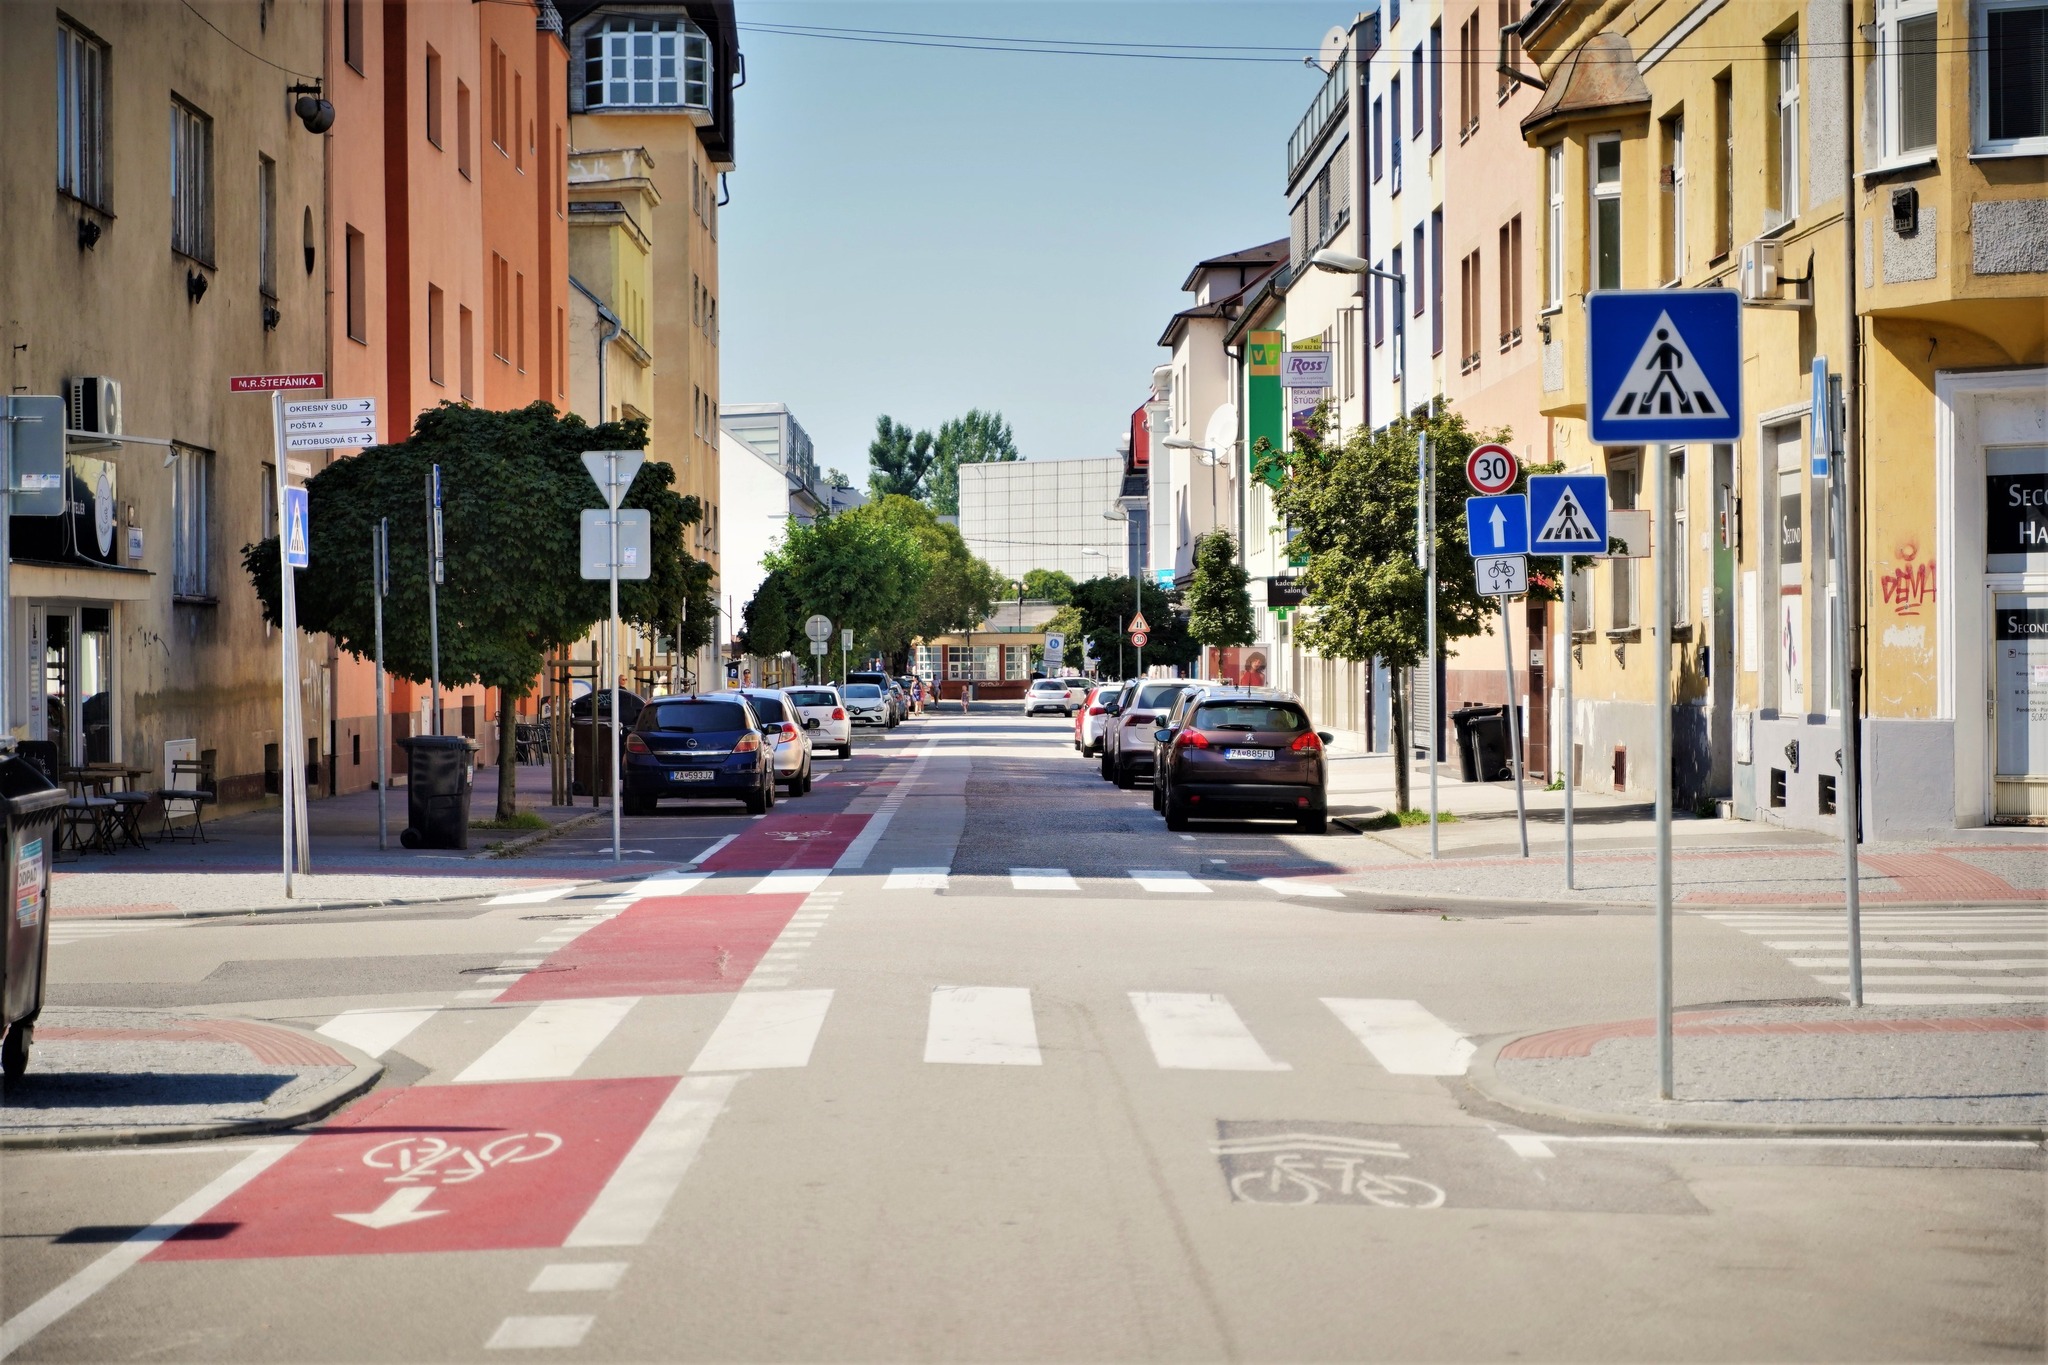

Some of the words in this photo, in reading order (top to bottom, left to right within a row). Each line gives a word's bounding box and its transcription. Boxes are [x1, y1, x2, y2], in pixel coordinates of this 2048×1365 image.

[1291, 358, 1323, 375] Ross
[238, 376, 317, 389] M.R.ŠTEFÁNIKA
[289, 402, 329, 413] OKRESNÝ
[331, 402, 348, 411] SÚD
[290, 420, 317, 430] POŠTA
[291, 436, 345, 446] AUTOBUSOVÁ
[347, 436, 359, 444] ST.
[1478, 457, 1507, 481] 30
[71, 500, 86, 515] TELIÉR
[1283, 586, 1301, 594] salón
[1135, 635, 1144, 643] 30
[730, 668, 737, 677] P
